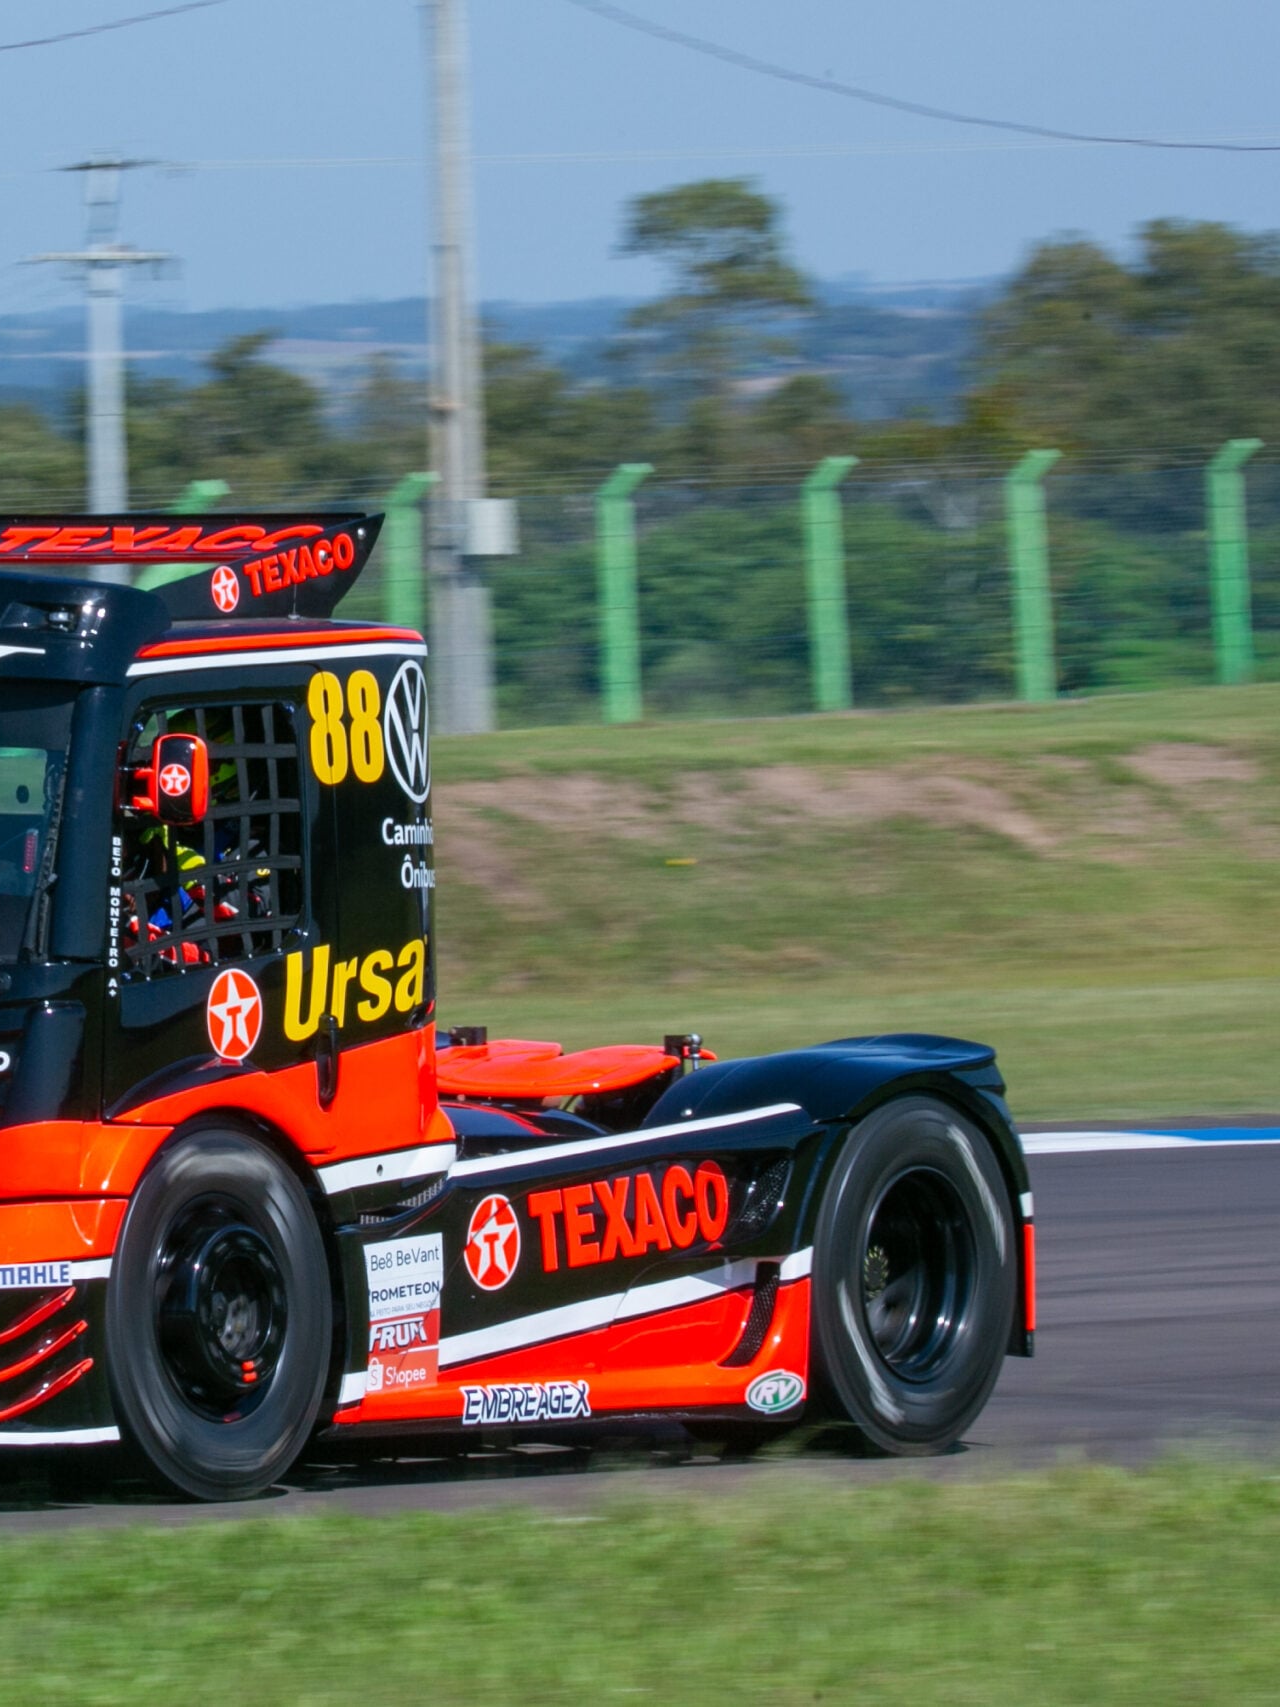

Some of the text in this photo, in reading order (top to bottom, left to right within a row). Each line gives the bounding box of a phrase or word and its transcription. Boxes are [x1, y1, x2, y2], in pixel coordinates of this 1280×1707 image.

[243, 532, 354, 597] TEXACO
[307, 670, 385, 785] 88
[111, 836, 122, 877] BETO
[109, 887, 121, 967] MONTEIRO
[284, 939, 426, 1042] Ursa
[528, 1160, 728, 1272] TEXACO
[371, 1246, 439, 1271] Be8 BeVant
[368, 1281, 440, 1303] ROMETEON
[386, 1367, 426, 1388] Shopee
[462, 1383, 590, 1421] EMBREAGEX
